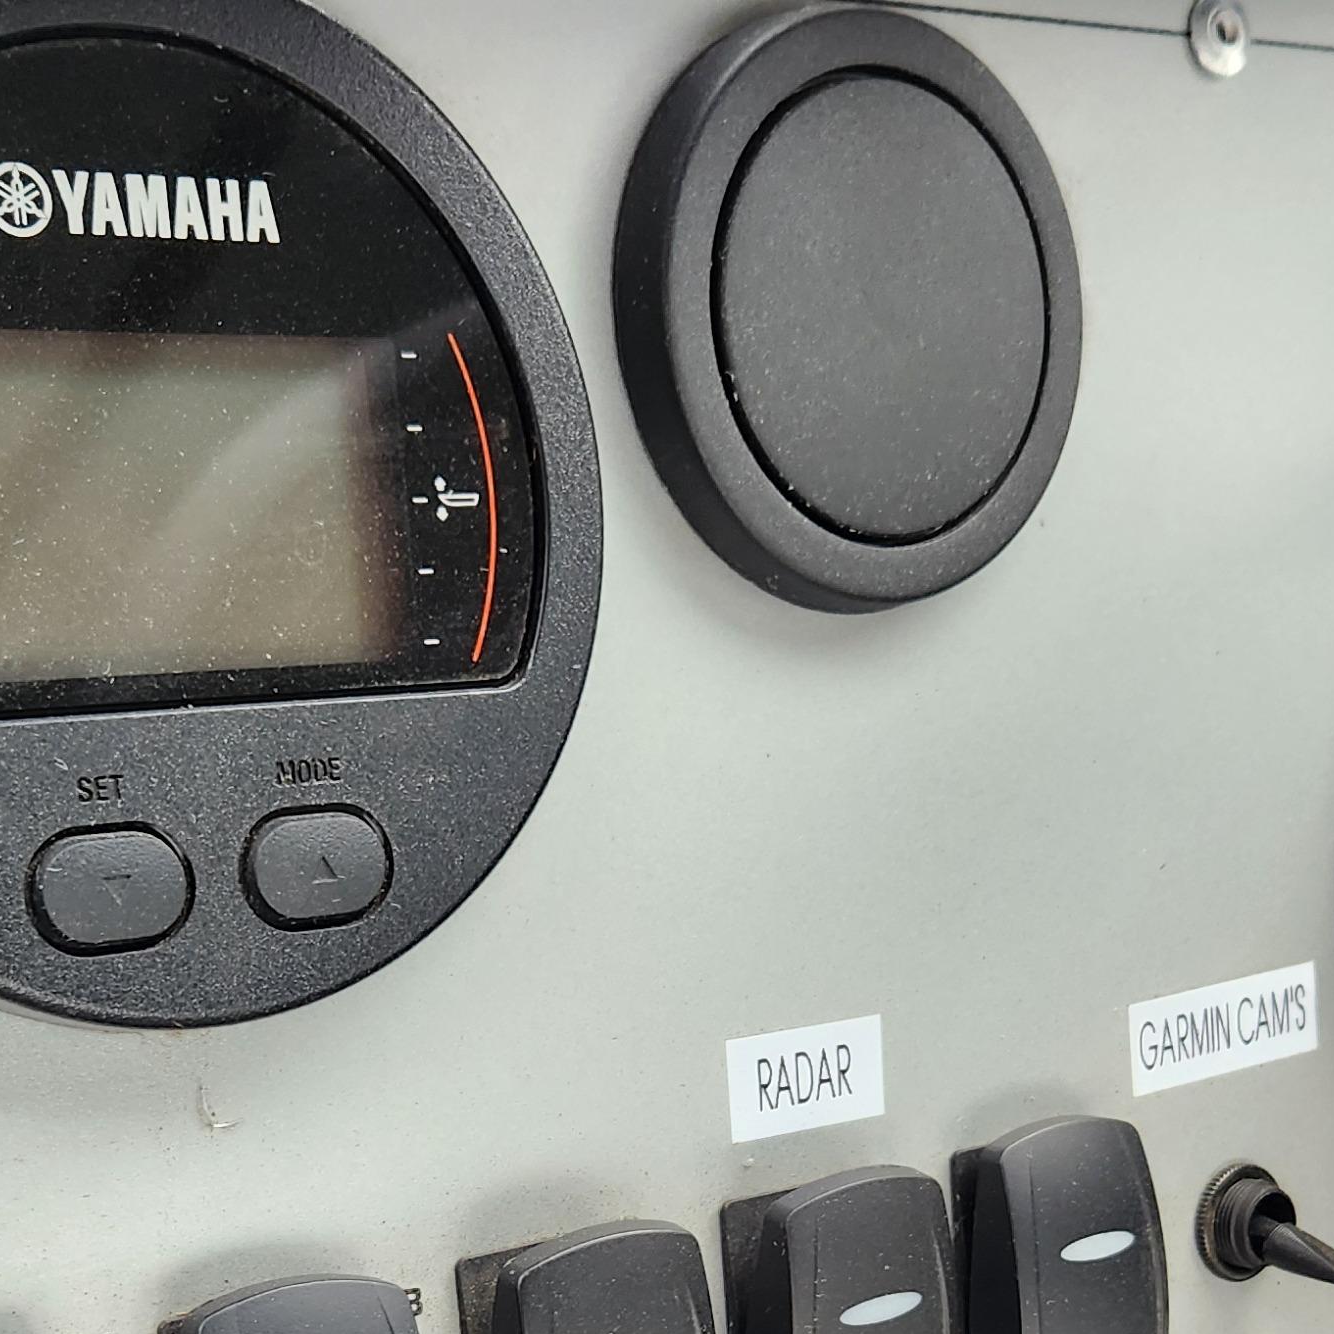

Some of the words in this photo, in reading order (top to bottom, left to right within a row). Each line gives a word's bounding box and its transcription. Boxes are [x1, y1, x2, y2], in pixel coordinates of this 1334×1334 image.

[51, 168, 281, 244] YAMAHA
[77, 774, 125, 802] SET
[275, 756, 343, 787] MODE
[1138, 1003, 1233, 1072] GARMIN
[1236, 983, 1308, 1047] CAM'S
[756, 1043, 854, 1113] RADAR
